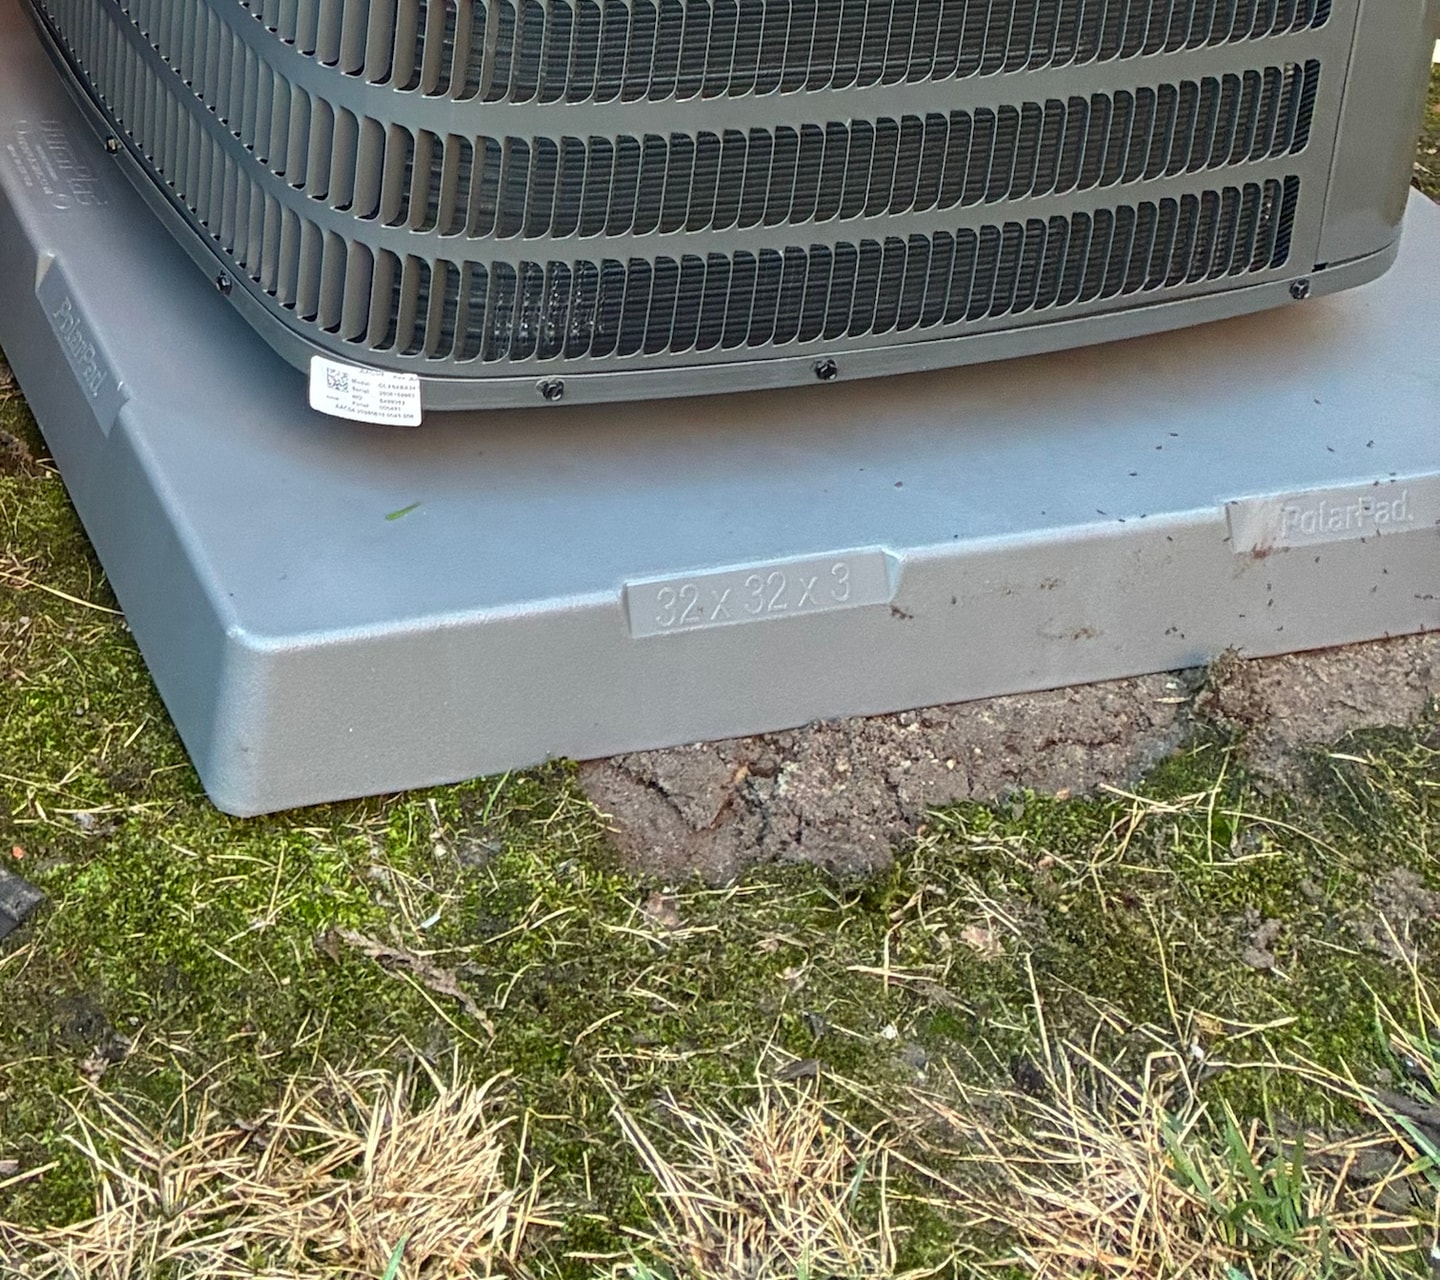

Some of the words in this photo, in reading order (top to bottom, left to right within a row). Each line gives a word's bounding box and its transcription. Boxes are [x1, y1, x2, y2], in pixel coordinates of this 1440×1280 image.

[656, 583, 700, 627] 32
[744, 570, 788, 615] 32
[830, 561, 851, 603] 3
